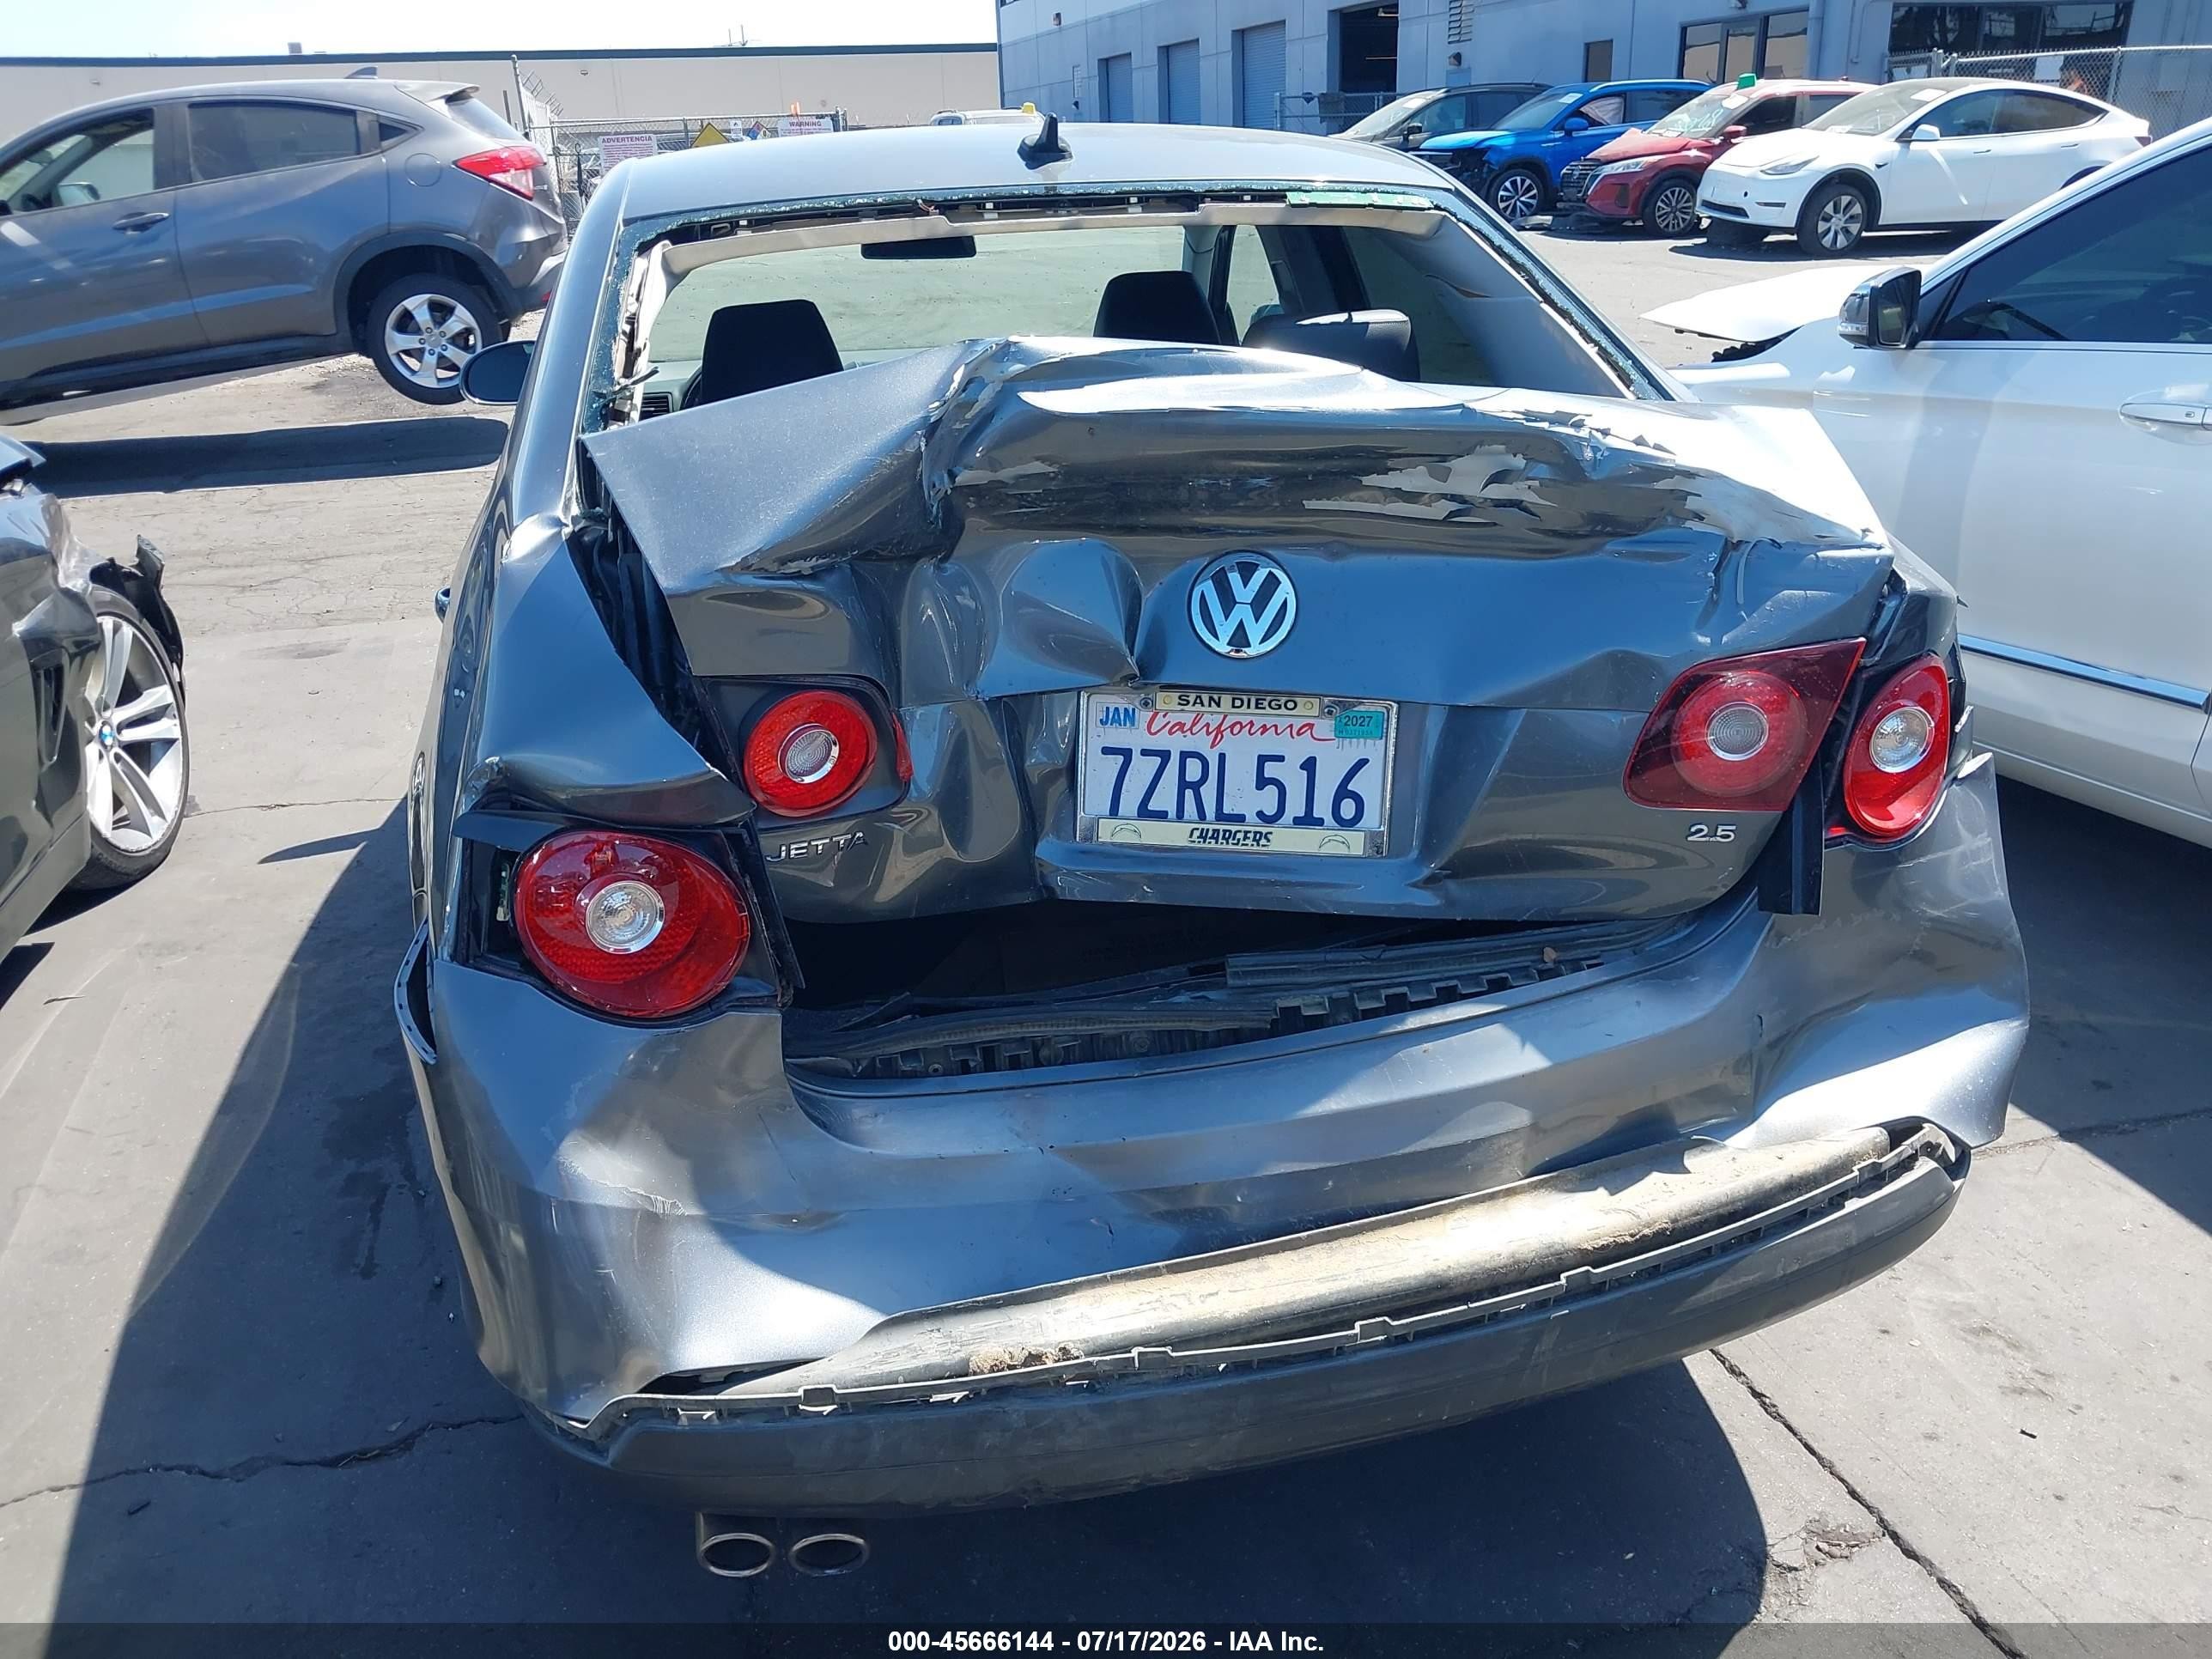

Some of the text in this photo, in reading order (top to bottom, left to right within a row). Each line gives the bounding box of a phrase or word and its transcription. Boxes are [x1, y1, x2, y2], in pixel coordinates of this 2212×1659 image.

[1177, 694, 1298, 711] SAN DIEGO
[1099, 706, 1136, 727] JAN
[1344, 714, 1374, 728] 2027
[1146, 712, 1336, 749] California
[1101, 746, 1370, 828] 7ZRL516
[765, 830, 869, 862] JETTA
[1188, 827, 1273, 848] CHARGERS
